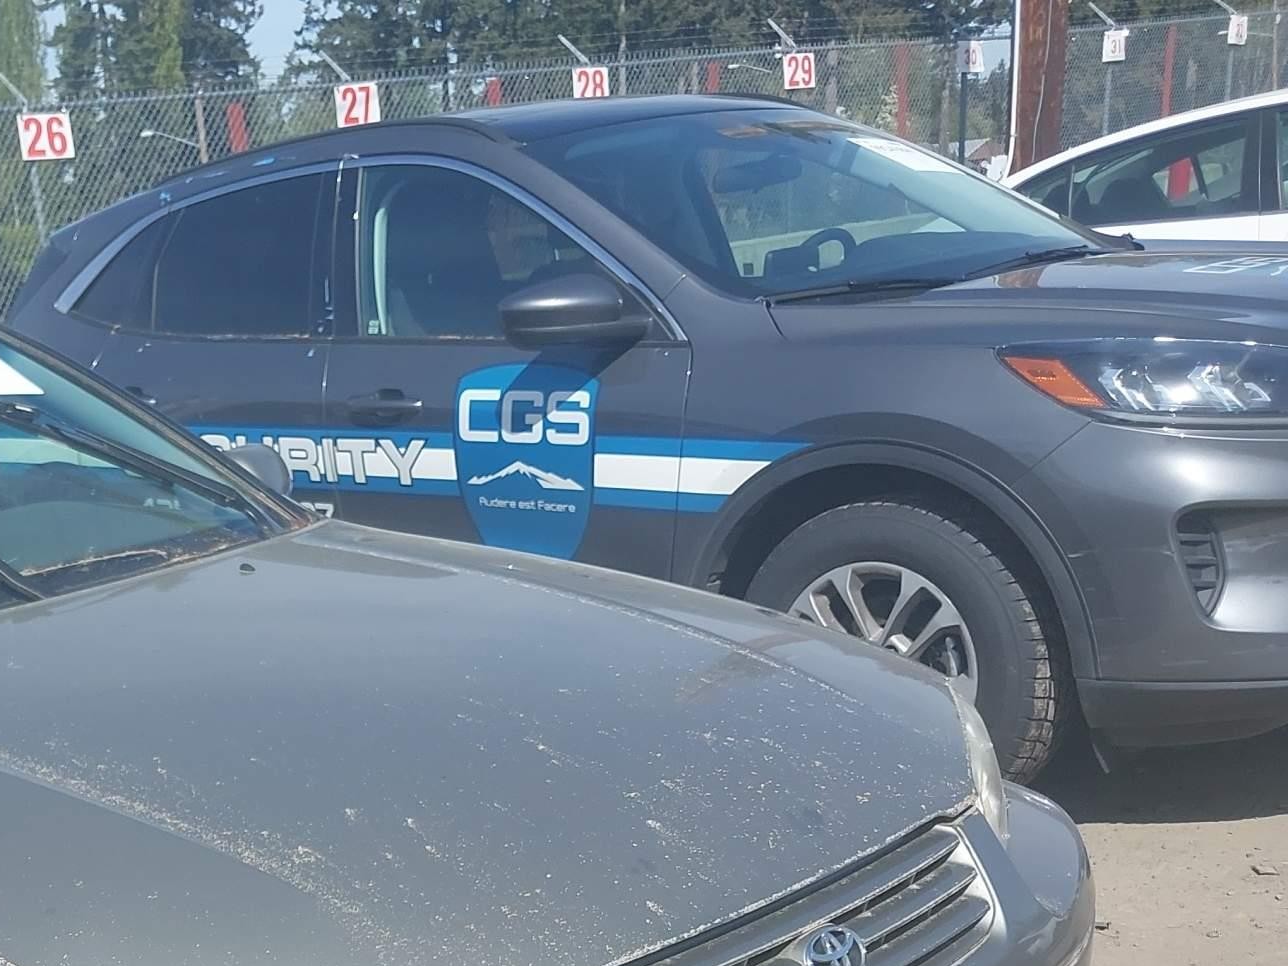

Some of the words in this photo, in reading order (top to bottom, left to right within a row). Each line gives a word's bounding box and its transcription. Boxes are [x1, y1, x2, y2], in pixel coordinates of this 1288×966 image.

[964, 49, 977, 65] 30
[1111, 39, 1121, 55] 31
[578, 70, 605, 97] 28
[788, 55, 812, 86] 29
[342, 86, 370, 124] 27
[24, 117, 67, 157] 26
[459, 388, 590, 446] CGS
[200, 434, 426, 486] RITY
[478, 496, 516, 509] Audere
[518, 501, 536, 510] est
[537, 500, 576, 513] Facere
